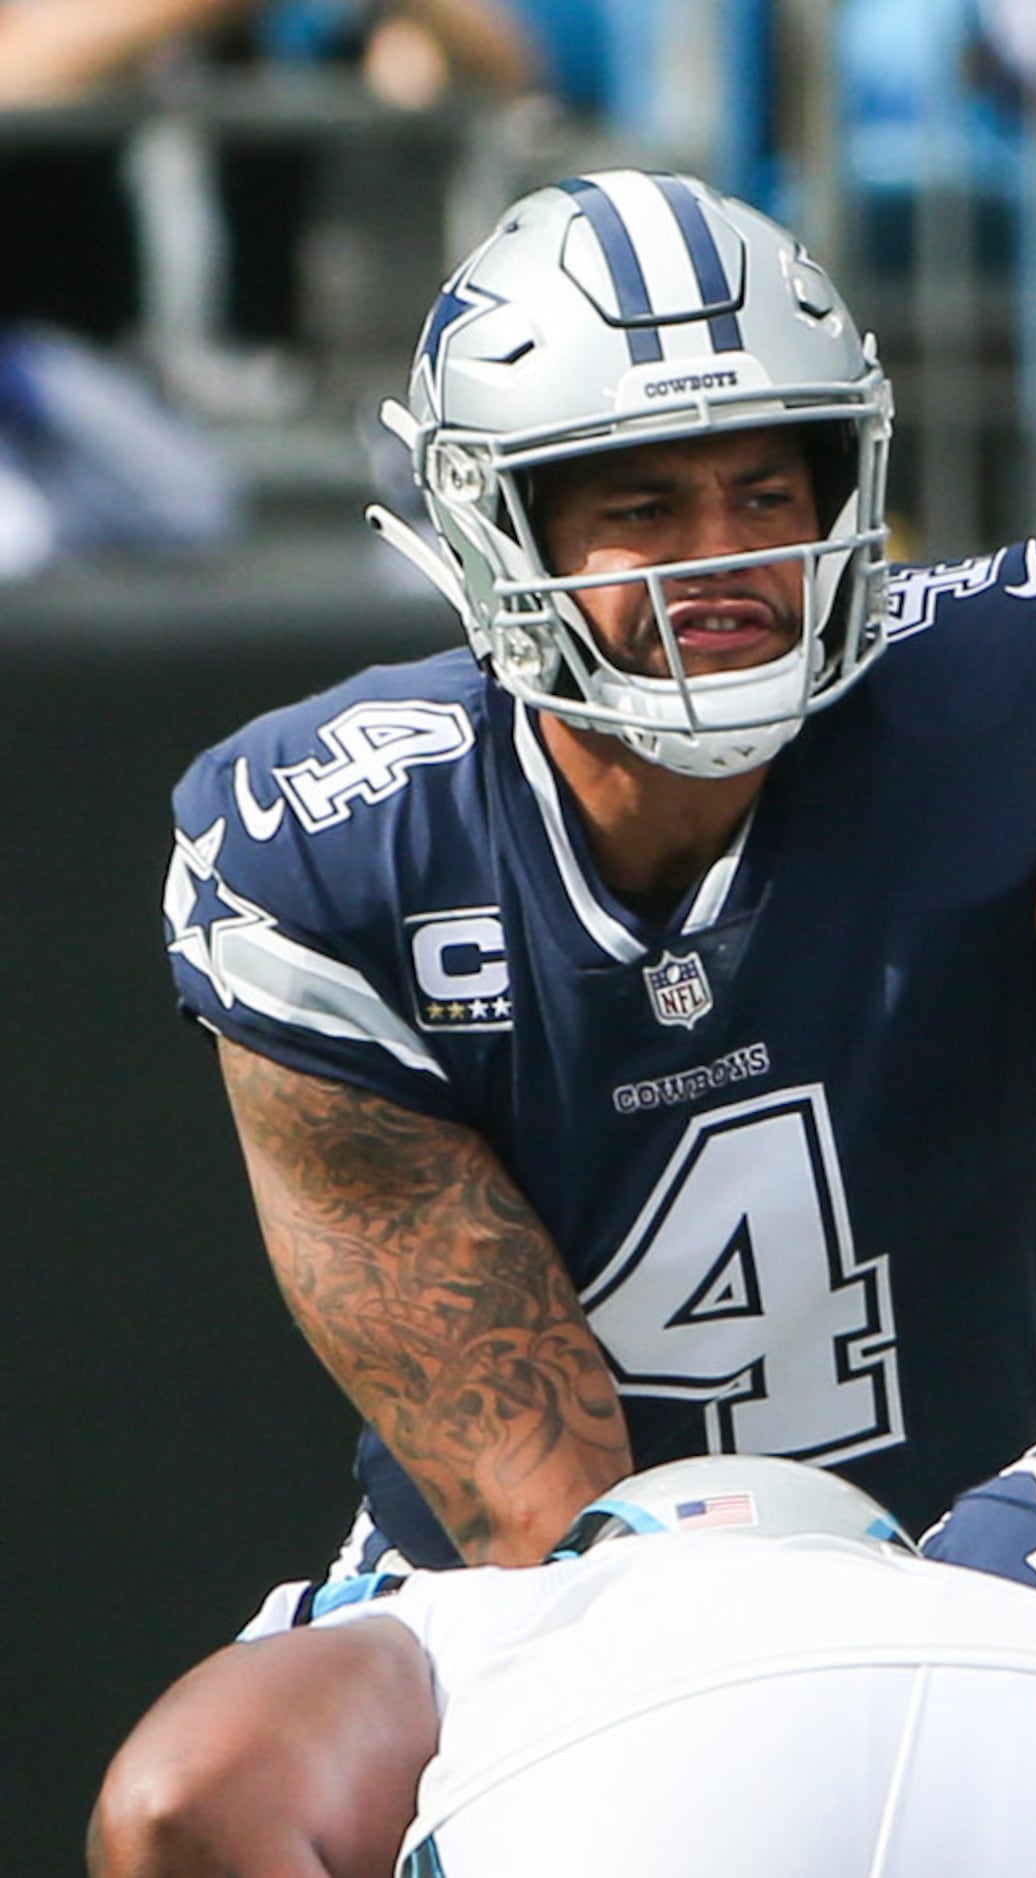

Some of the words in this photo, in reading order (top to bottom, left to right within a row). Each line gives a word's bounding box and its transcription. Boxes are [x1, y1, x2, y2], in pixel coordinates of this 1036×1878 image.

[644, 370, 738, 398] COWBOYS
[270, 700, 476, 835] 4
[411, 917, 511, 1000] C
[661, 983, 705, 1015] NFL
[612, 1041, 771, 1114] COWBOYS
[578, 1083, 906, 1469] 4
